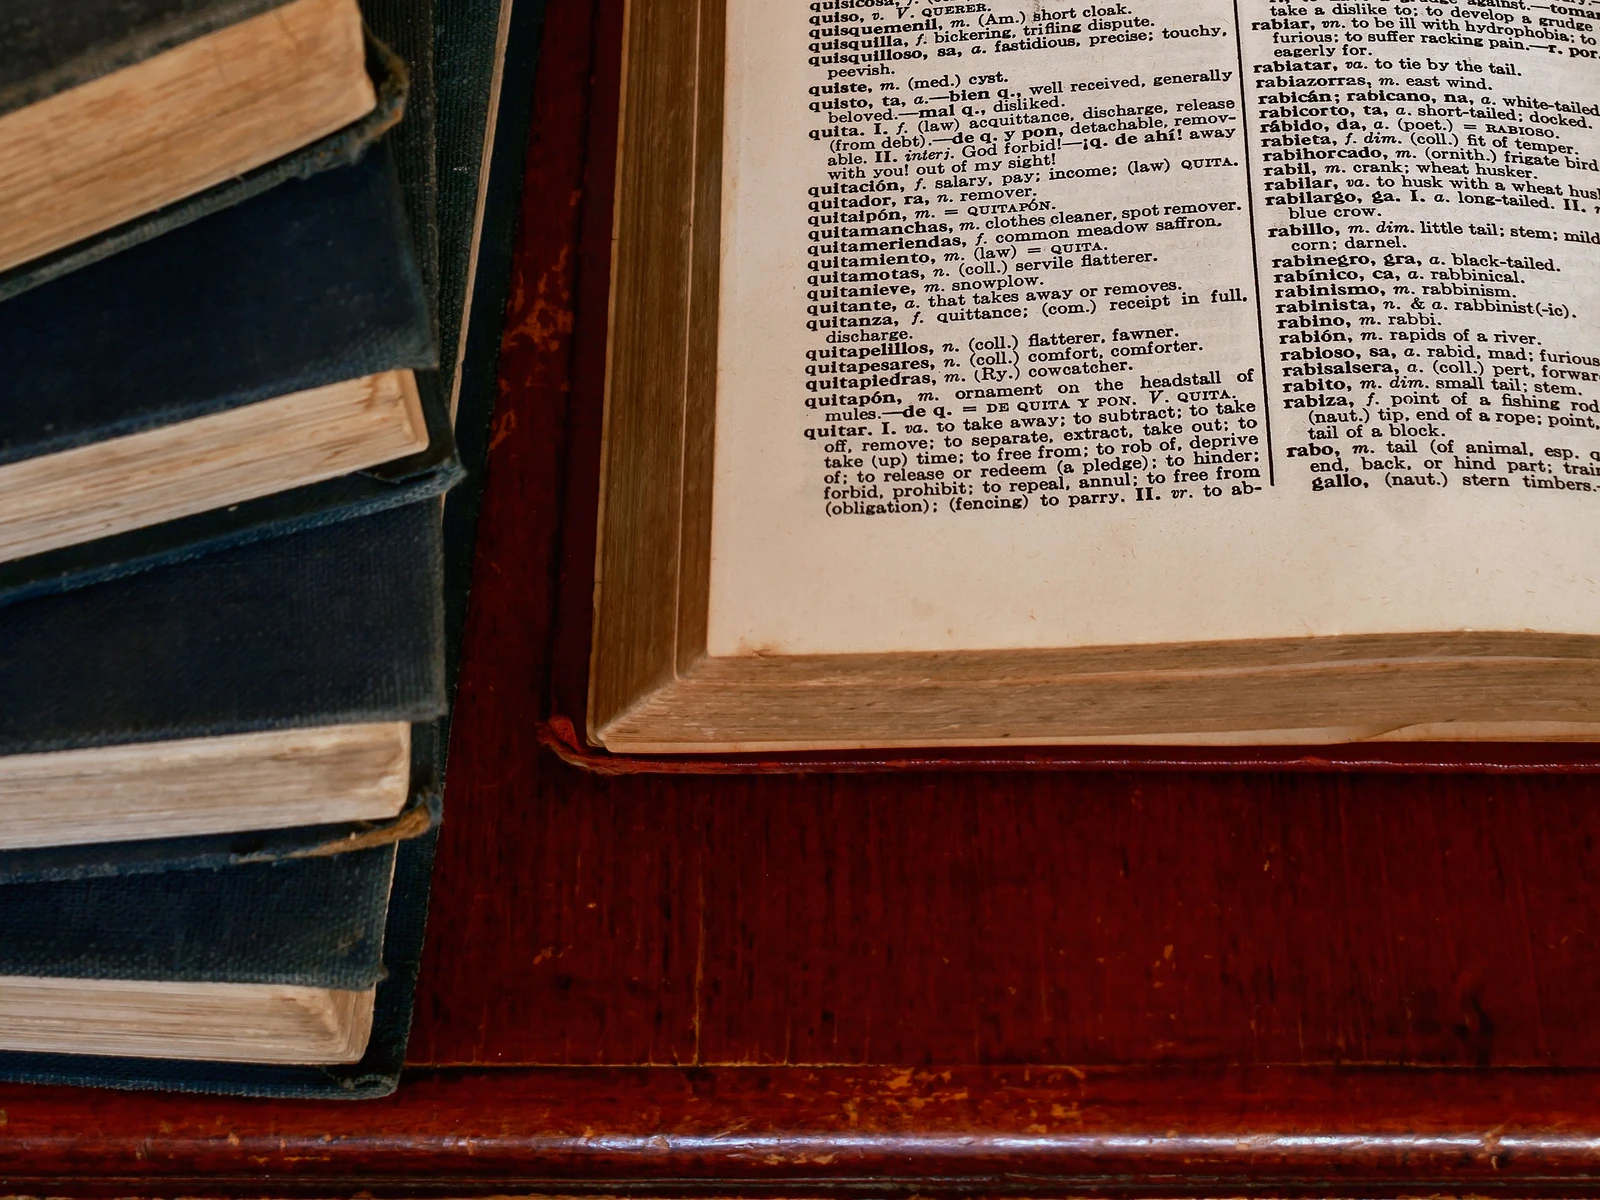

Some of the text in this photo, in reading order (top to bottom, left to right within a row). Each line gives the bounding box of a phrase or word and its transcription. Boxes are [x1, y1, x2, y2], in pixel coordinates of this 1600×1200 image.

[808, 2, 1133, 41] quisquemenil, m. (Am.) short cloak.
[1273, 44, 1373, 61] eagerly for.
[827, 63, 896, 81] peevish.
[808, 71, 1009, 98] quiste, m. (med.) cyst.
[1255, 75, 1493, 91] rabiazorras, m. east wind.
[807, 187, 1038, 213] quitador, ra, n. remover.
[1286, 207, 1382, 220] blue crow.
[1290, 236, 1407, 251] corn; darnel.
[806, 252, 1158, 287] quitamotas, n. (coll.) servile flatterer.
[1270, 253, 1561, 273] rabinegro, gra, a. black-tailed.
[806, 275, 1045, 302] quitanieve, m. snowplow.
[1274, 282, 1517, 299] rabinismo, m. rabbinism.
[1276, 312, 1442, 330] rabino, m. rabbi.
[825, 329, 916, 345] discharge.
[805, 359, 1136, 393] quitapiedras, m. (Ry.) cowcatcher.
[1306, 424, 1446, 440] tail of a block.
[825, 480, 1263, 518] (obligation); (fencing) to parry. II. vr. to ab-
